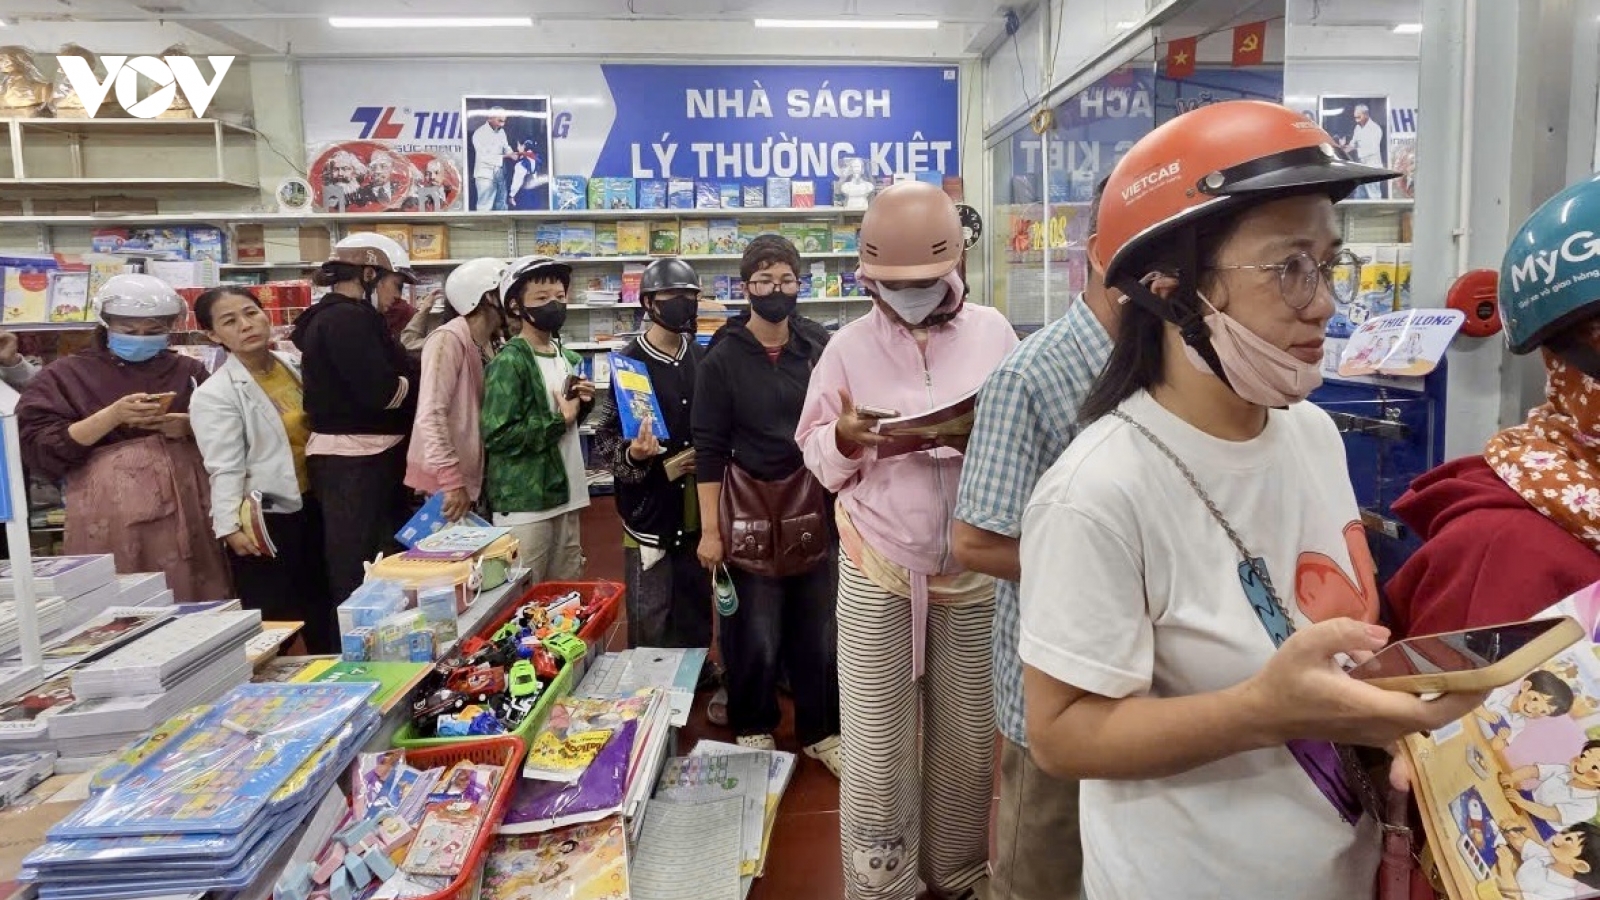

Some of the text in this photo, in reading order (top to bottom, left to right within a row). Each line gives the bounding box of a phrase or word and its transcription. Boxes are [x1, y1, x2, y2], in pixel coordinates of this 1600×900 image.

[686, 80, 890, 118] NHÀ SÁCH
[631, 132, 678, 179] LÝ
[691, 132, 855, 178] THƯỜNG
[1121, 162, 1181, 201] VIETCAB
